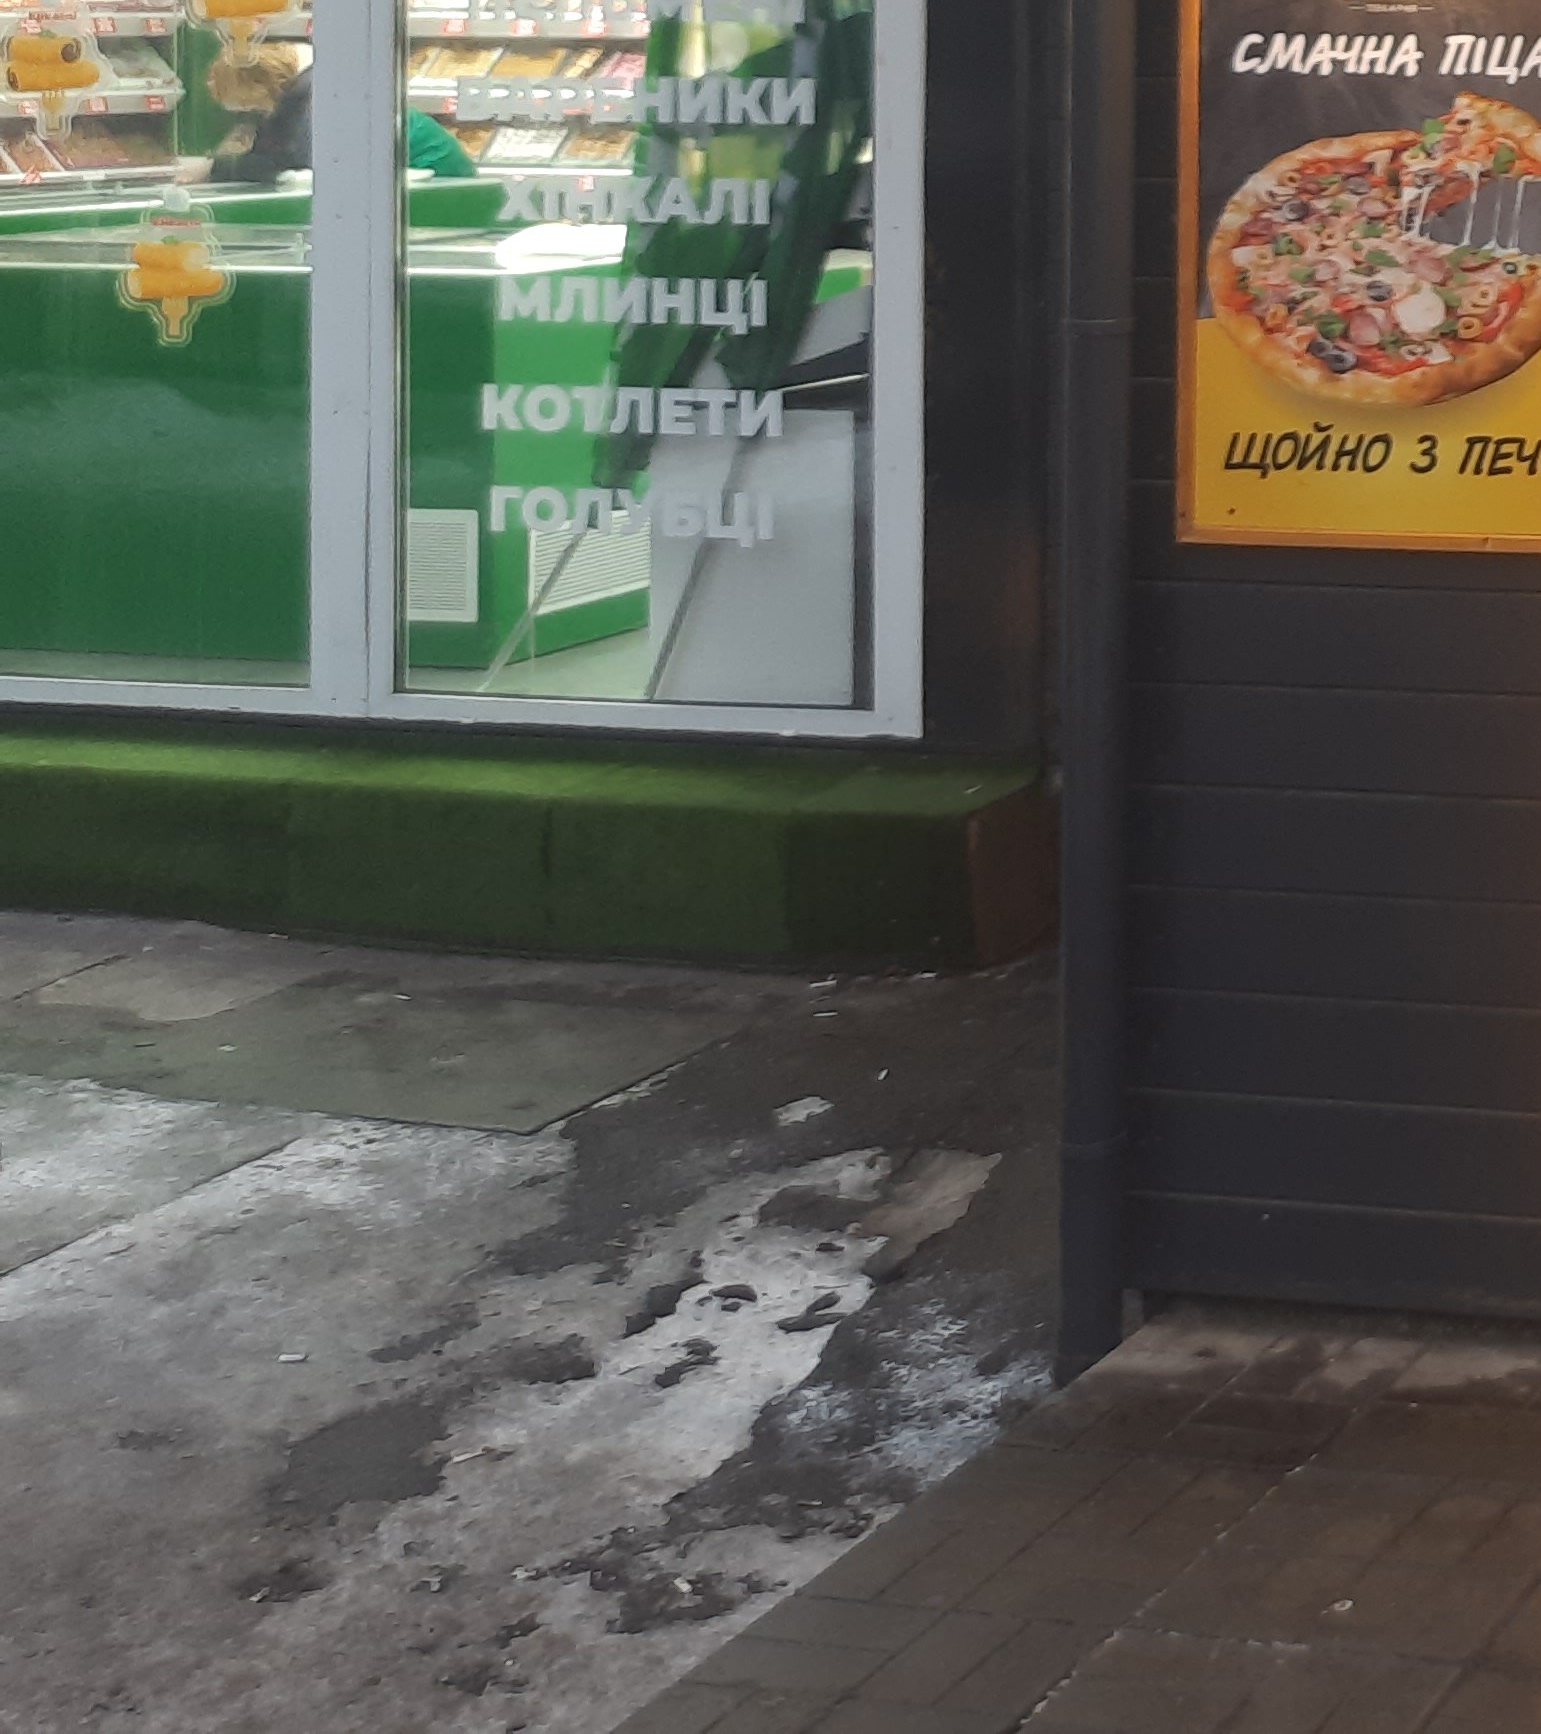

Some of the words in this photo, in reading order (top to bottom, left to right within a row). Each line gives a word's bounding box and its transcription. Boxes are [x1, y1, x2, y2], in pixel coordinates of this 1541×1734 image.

[1232, 32, 1424, 79] СМАЧНА
[455, 76, 817, 125] ВАРЕНИКИ
[501, 175, 771, 225] ХІНКАЛІ
[499, 278, 767, 333] МЛИНЦІ
[481, 382, 784, 439] КОТЛЕТИ
[1224, 421, 1391, 479] ЩОЙНО
[489, 485, 776, 548] ГОЛУБЦІ
